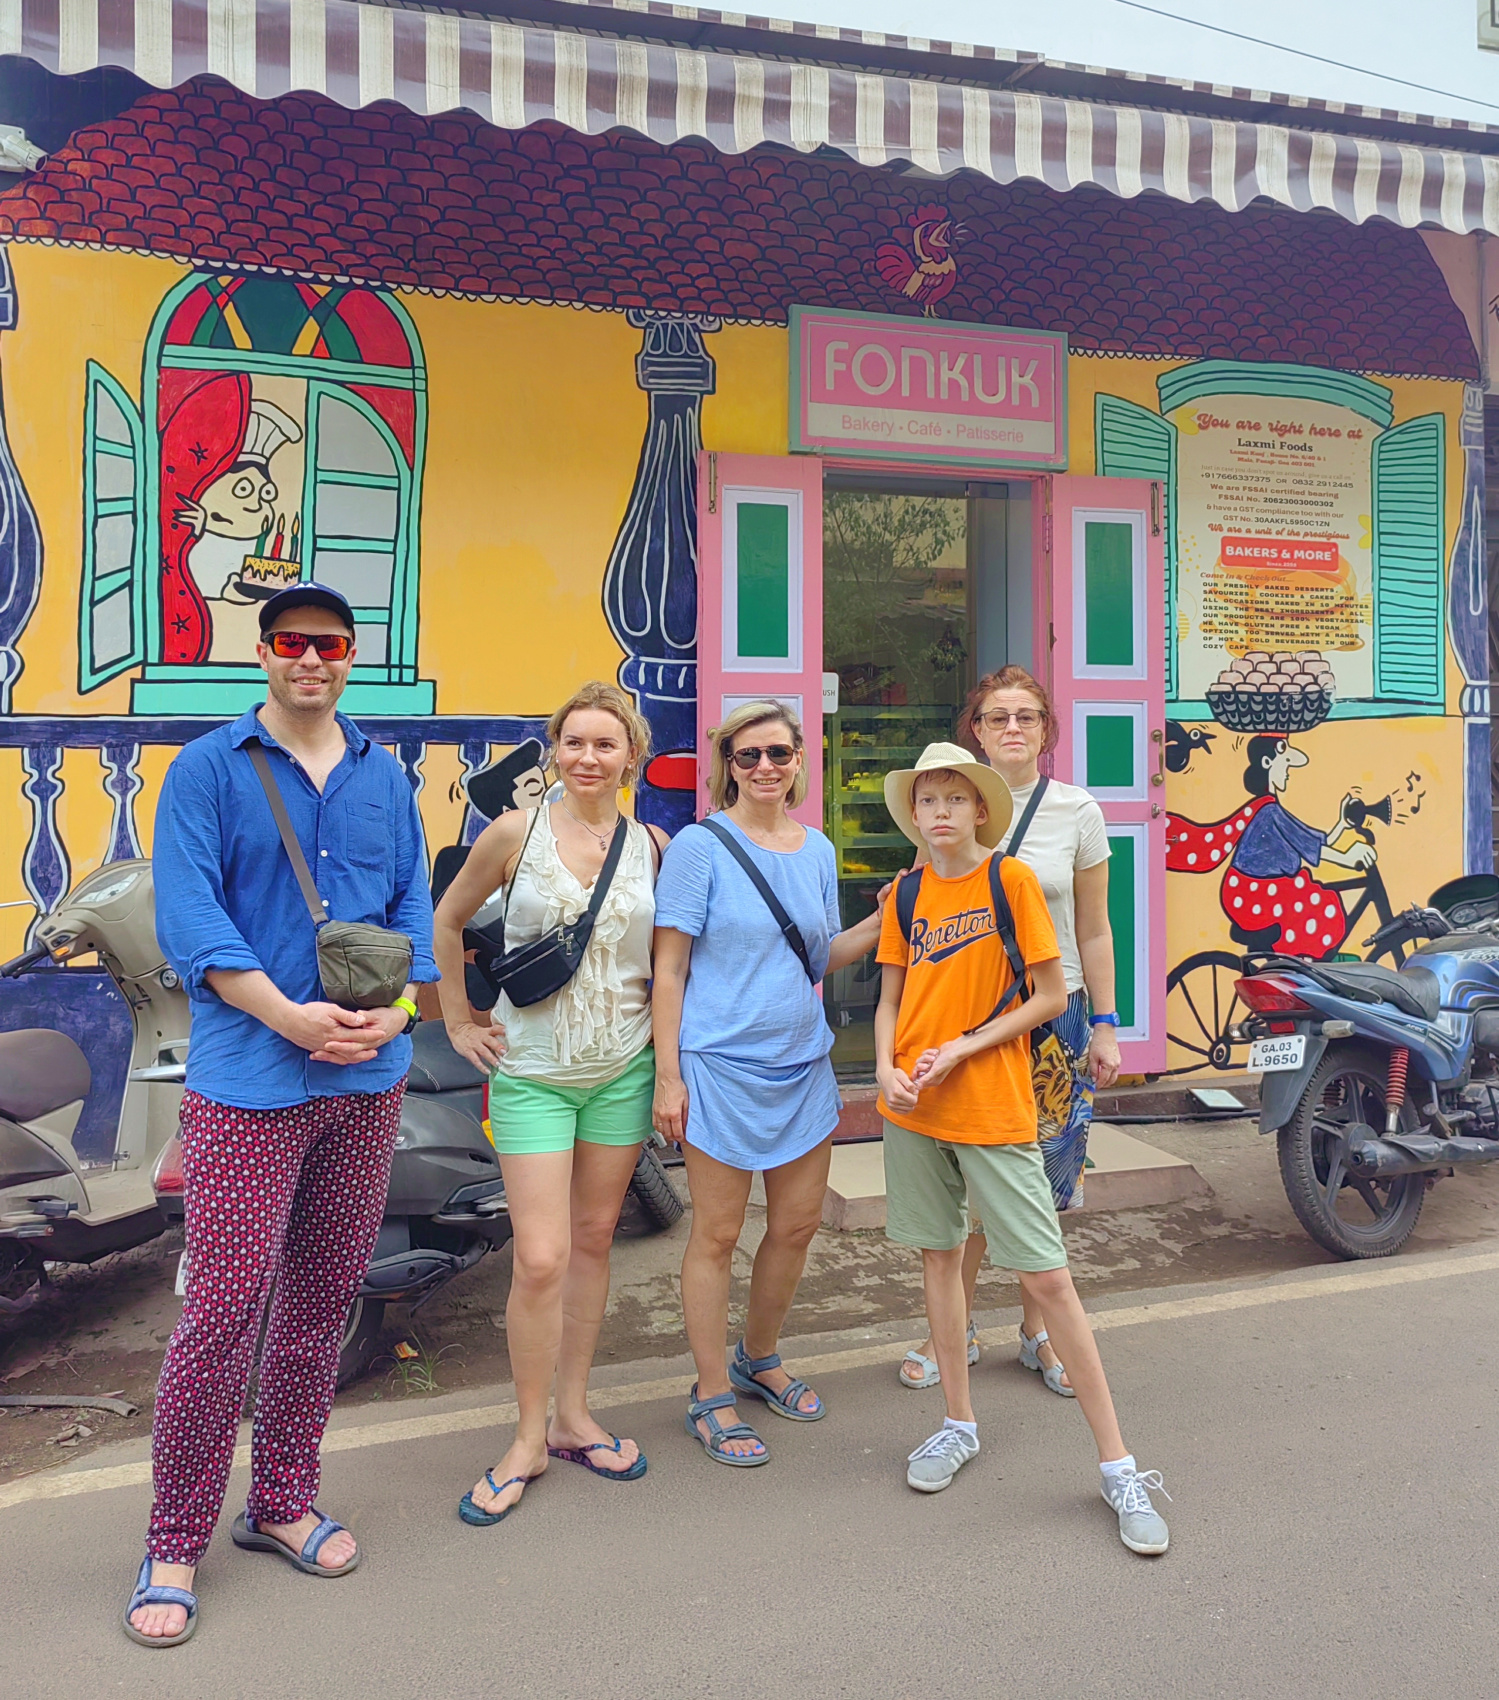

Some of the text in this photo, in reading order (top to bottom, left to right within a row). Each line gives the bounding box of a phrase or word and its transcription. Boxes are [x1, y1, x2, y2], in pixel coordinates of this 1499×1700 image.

[825, 341, 1040, 408] FONKUK
[841, 414, 1024, 444] Bakery Café Patisserie
[1196, 412, 1364, 440] You are right here at
[1237, 437, 1314, 453] Laxmi Foods
[1292, 478, 1314, 486] 0832
[1218, 493, 1244, 502] FSSAI
[1242, 486, 1268, 494] FSSAI
[1270, 488, 1306, 496] certified
[1307, 490, 1340, 500] bearing
[1213, 504, 1232, 512] have
[1239, 505, 1255, 513] GST
[1255, 507, 1300, 516] compliance
[1222, 514, 1239, 522] GST
[1207, 522, 1224, 533] We
[1226, 526, 1243, 534] are
[1254, 527, 1273, 535] unit
[1275, 527, 1286, 536] of
[1286, 528, 1301, 537] the
[1302, 530, 1351, 541] prestigious
[1225, 545, 1332, 561] BAKERS & MORE
[1200, 571, 1225, 580] Come
[1244, 574, 1271, 582] Check
[1280, 608, 1335, 616] INGREDIENTS
[822, 689, 836, 697] USH
[911, 907, 995, 967] Benetton
[1261, 1041, 1292, 1054] GA.03
[1251, 1053, 1298, 1068] L.9650
